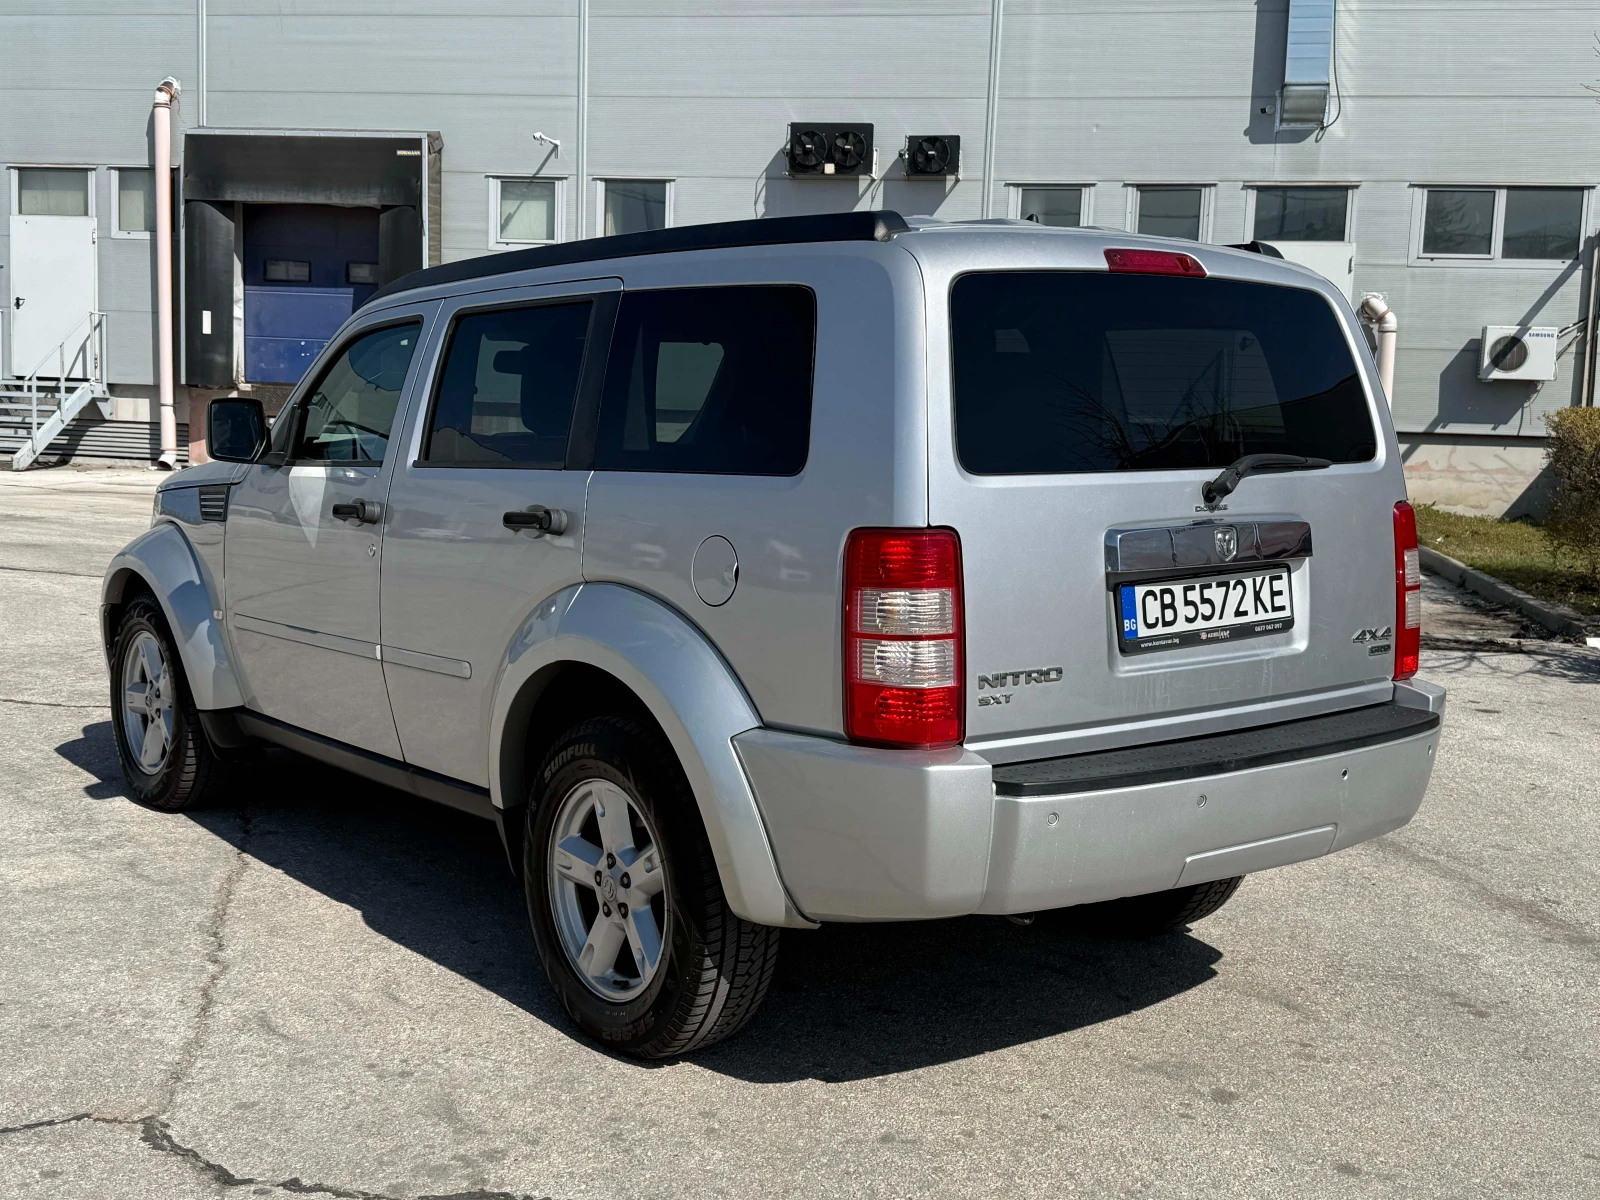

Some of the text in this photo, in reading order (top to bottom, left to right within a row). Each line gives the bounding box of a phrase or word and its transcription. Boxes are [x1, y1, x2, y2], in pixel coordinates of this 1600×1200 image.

[1124, 619, 1136, 631] BG
[978, 666, 1063, 690] NITRO
[978, 692, 1014, 707] SXT
[544, 742, 596, 784] SUNFULL
